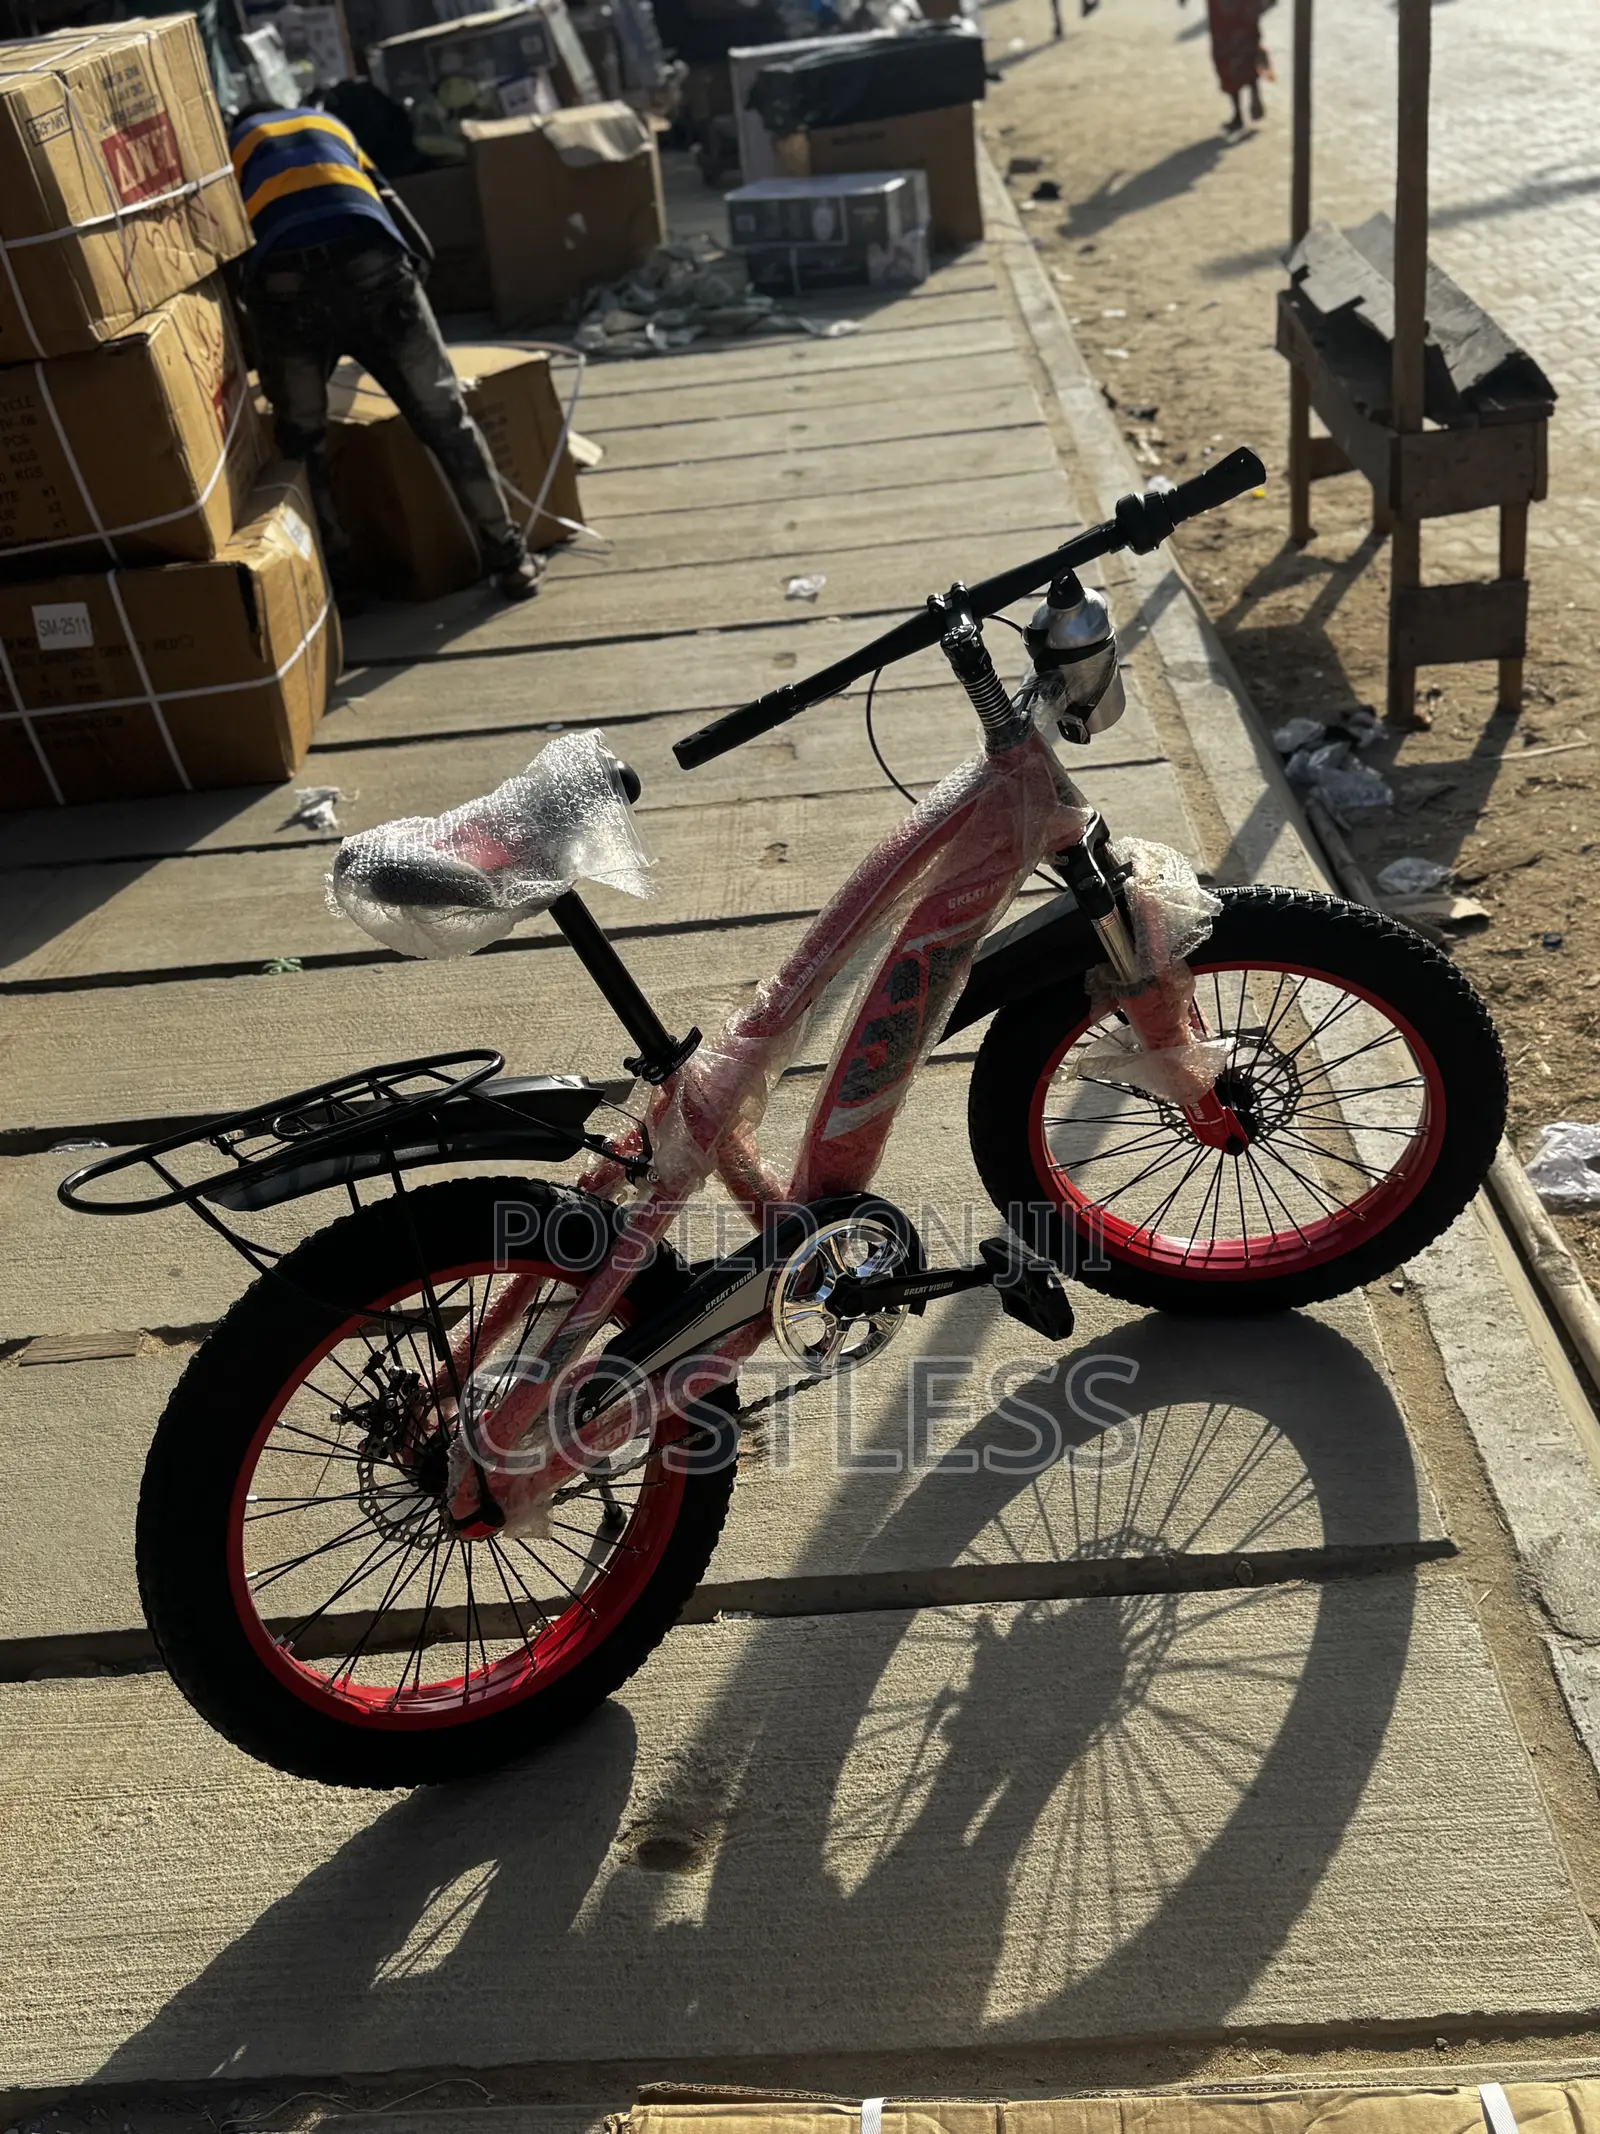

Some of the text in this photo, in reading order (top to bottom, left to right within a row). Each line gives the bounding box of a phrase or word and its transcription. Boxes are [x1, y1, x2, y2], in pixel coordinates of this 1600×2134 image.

[38, 616, 90, 638] SM-2511
[948, 886, 986, 909] GREAT
[705, 1267, 757, 1312] GREAT VISION
[903, 1280, 954, 1297] GREAT VISION
